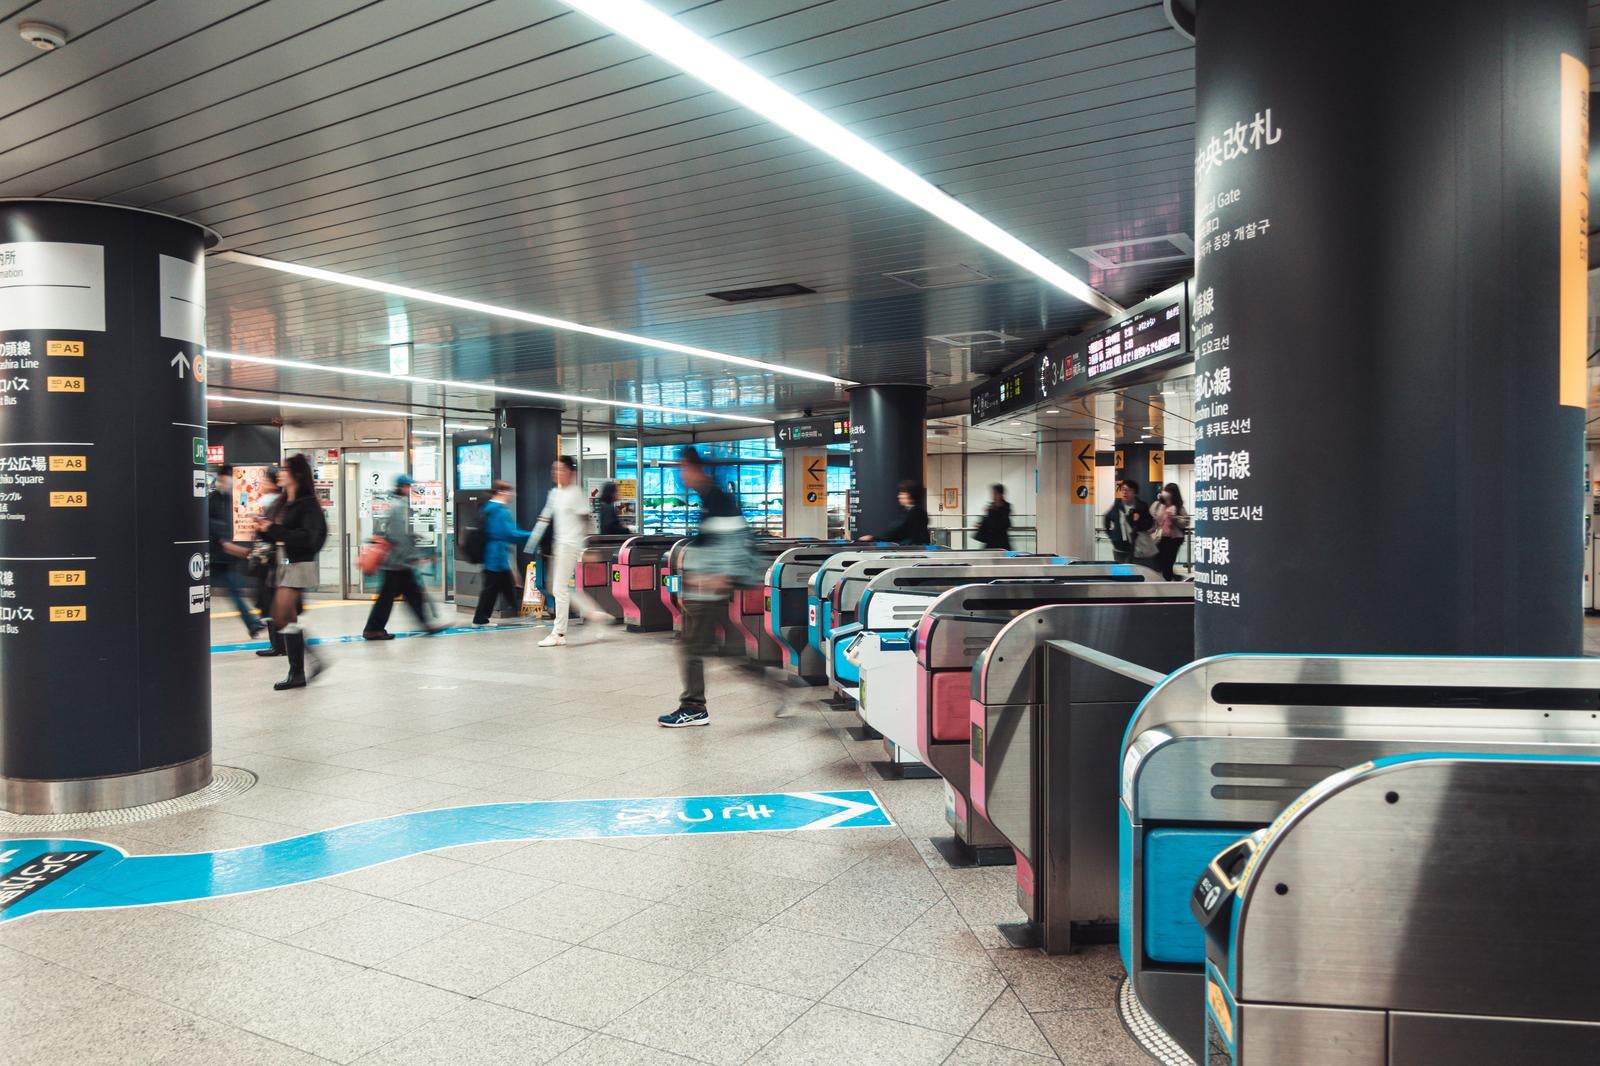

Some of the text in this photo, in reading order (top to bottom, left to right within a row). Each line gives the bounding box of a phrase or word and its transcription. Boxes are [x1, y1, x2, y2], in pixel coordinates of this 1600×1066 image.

[1217, 188, 1241, 208] Gate
[1213, 231, 1231, 251] 중앙
[1234, 218, 1271, 241] 개찰구
[63, 344, 80, 354] A5
[20, 358, 40, 369] Line
[64, 380, 81, 389] A8
[1211, 400, 1229, 418] Line
[1206, 417, 1251, 438] 후쿠토신선
[195, 443, 205, 458] JR
[65, 459, 82, 468] A8
[14, 473, 45, 487] Square
[66, 495, 83, 504] A8
[1218, 486, 1239, 501] Line
[65, 574, 80, 583] B7
[1211, 569, 1229, 586] Line
[66, 609, 81, 618] B7
[6, 623, 19, 634] Bus
